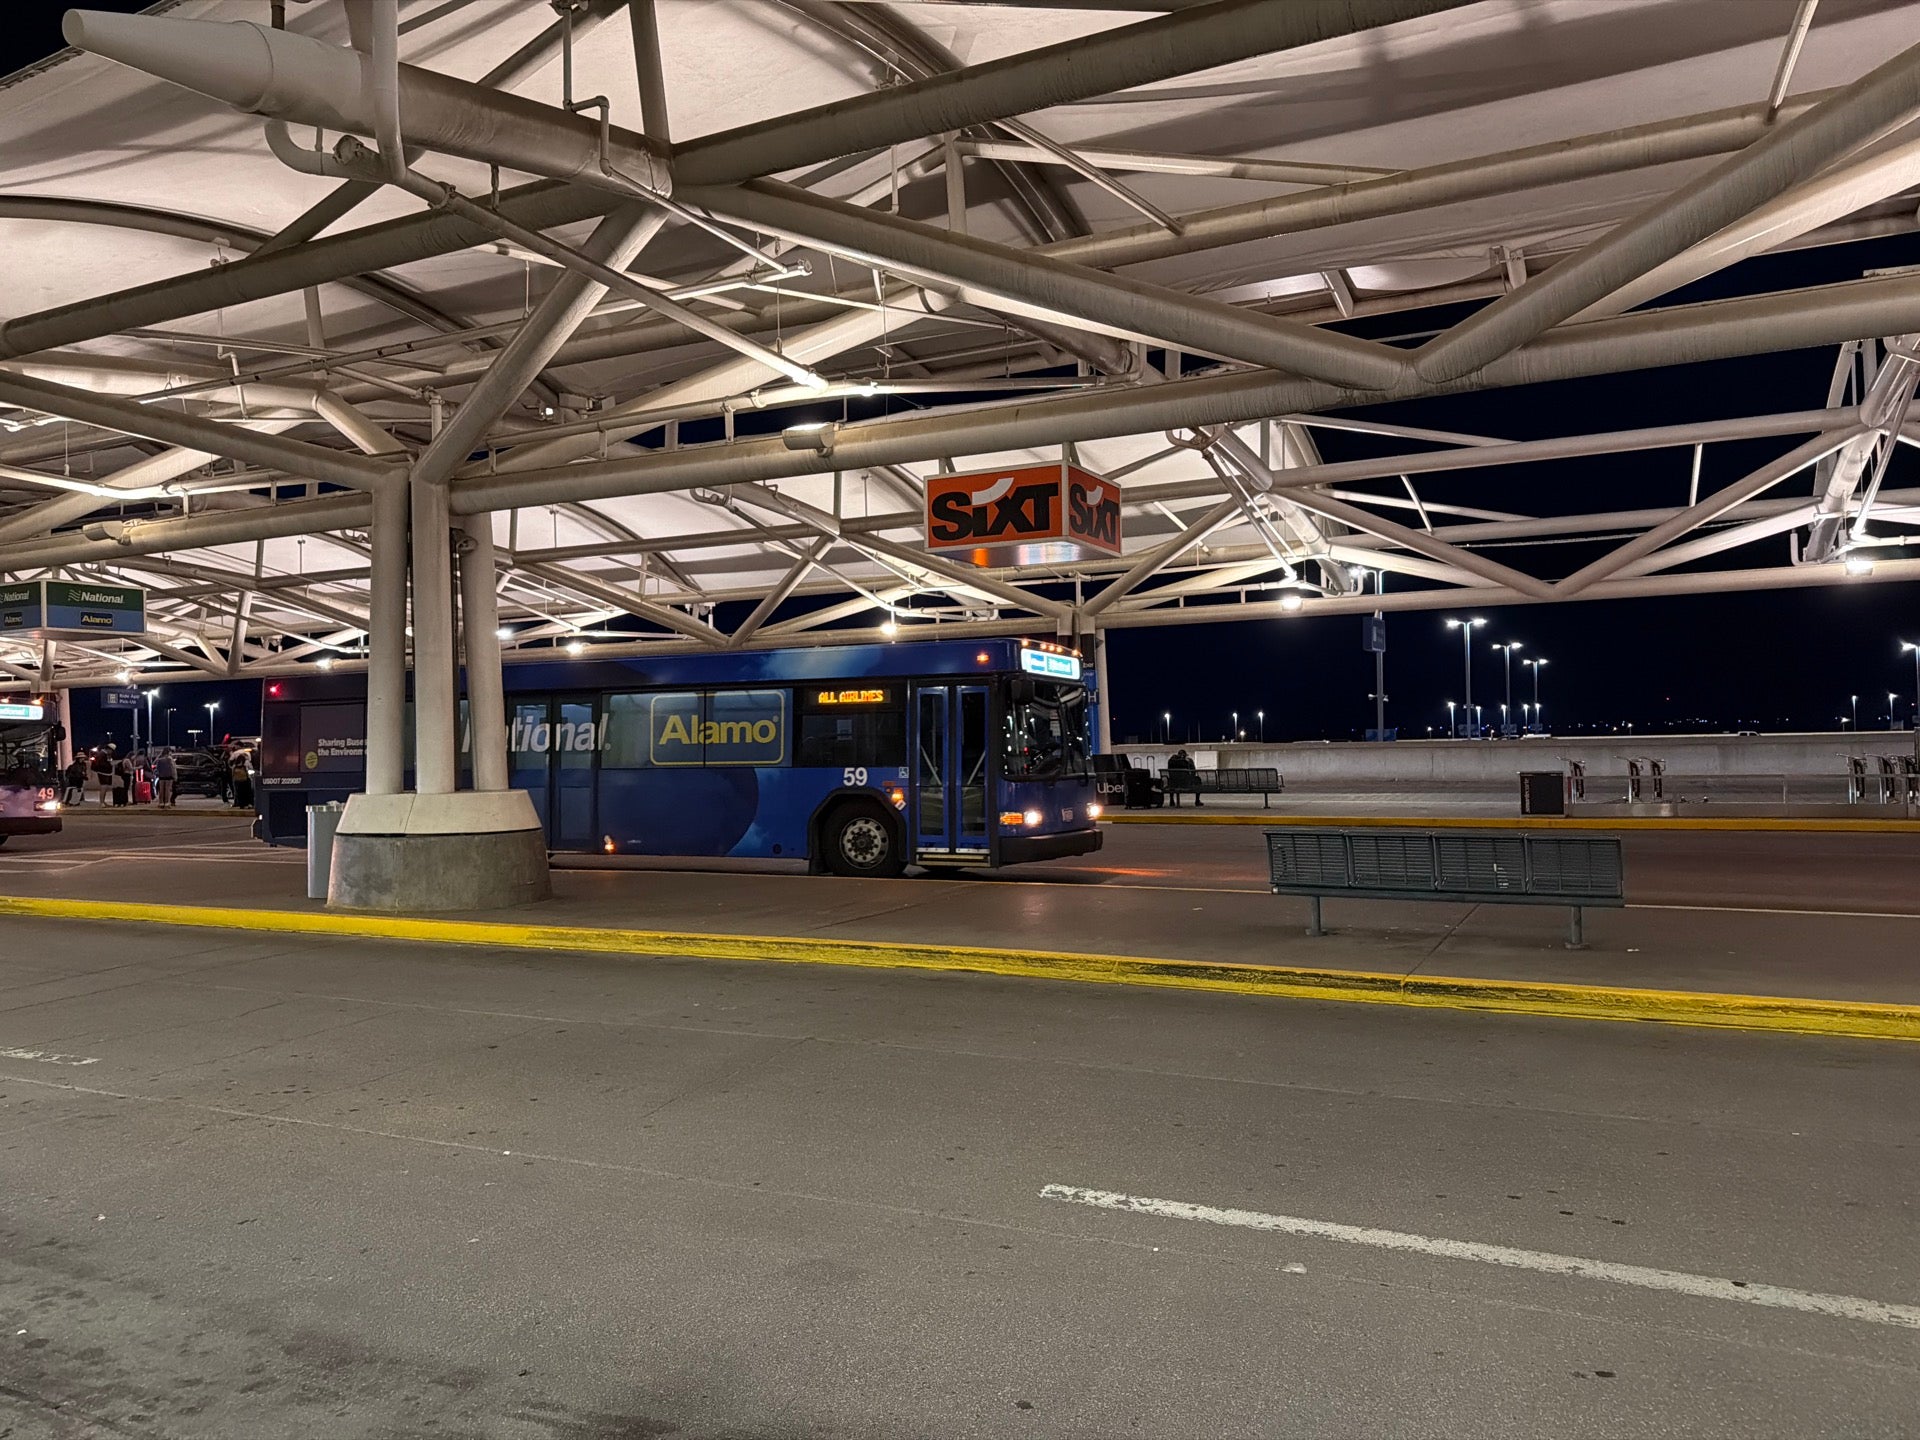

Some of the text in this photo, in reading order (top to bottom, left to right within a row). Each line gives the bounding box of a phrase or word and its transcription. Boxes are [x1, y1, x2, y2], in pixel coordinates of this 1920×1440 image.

[4, 590, 30, 602] National
[81, 591, 124, 604] National
[81, 615, 113, 624] Alamo
[818, 690, 884, 704] ALL AIRLINES
[658, 715, 777, 745] Alamo
[318, 738, 368, 748] Sharing Buse
[317, 748, 330, 756] the
[843, 767, 868, 787] 59
[39, 787, 54, 800] 49
[1096, 782, 1125, 794] Uber
